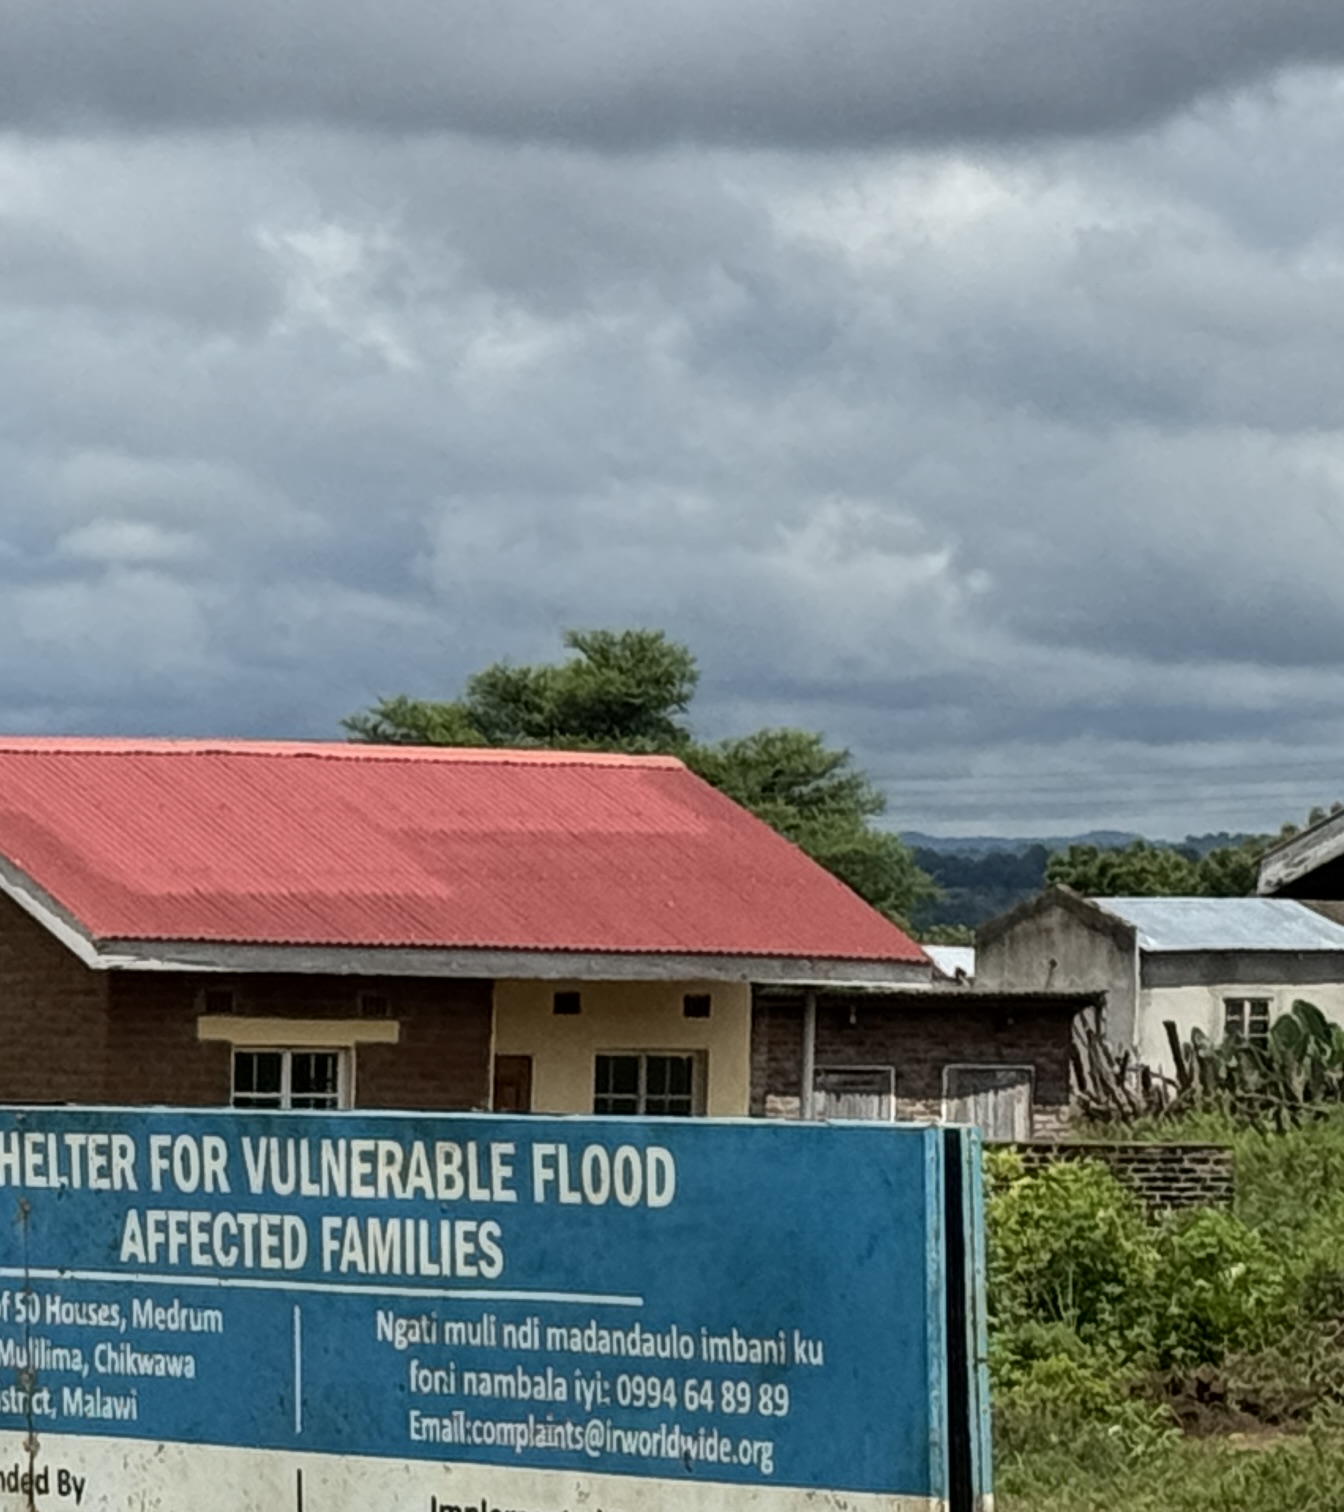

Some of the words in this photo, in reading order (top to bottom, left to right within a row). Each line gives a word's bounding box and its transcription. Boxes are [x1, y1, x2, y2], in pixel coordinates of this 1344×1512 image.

[149, 1133, 232, 1194] FOR
[241, 1135, 518, 1202] VULNERABLE
[532, 1142, 676, 1208] FLOOD
[120, 1207, 309, 1271] AFFECTED
[322, 1215, 504, 1279] FAMILIES
[14, 1292, 41, 1324] 50
[45, 1294, 127, 1333] Houses,
[132, 1298, 224, 1334] Medrum
[375, 1309, 438, 1351] Ngati
[444, 1312, 497, 1348] muli
[503, 1316, 541, 1350] ndi
[546, 1318, 695, 1361] madandaulo
[701, 1326, 787, 1366] imbani
[794, 1328, 825, 1367] ku
[93, 1342, 197, 1380] Chikwawa
[410, 1359, 456, 1395] foni
[463, 1364, 568, 1402] nambala
[574, 1368, 612, 1413] iyi:
[617, 1373, 677, 1412] 0994
[684, 1378, 715, 1413] 64
[721, 1380, 752, 1415] 89
[758, 1383, 791, 1418] 89
[63, 1386, 138, 1421] Malawi
[409, 1409, 774, 1476] Email:complaints@irworldwide.org
[57, 1468, 86, 1506] By
